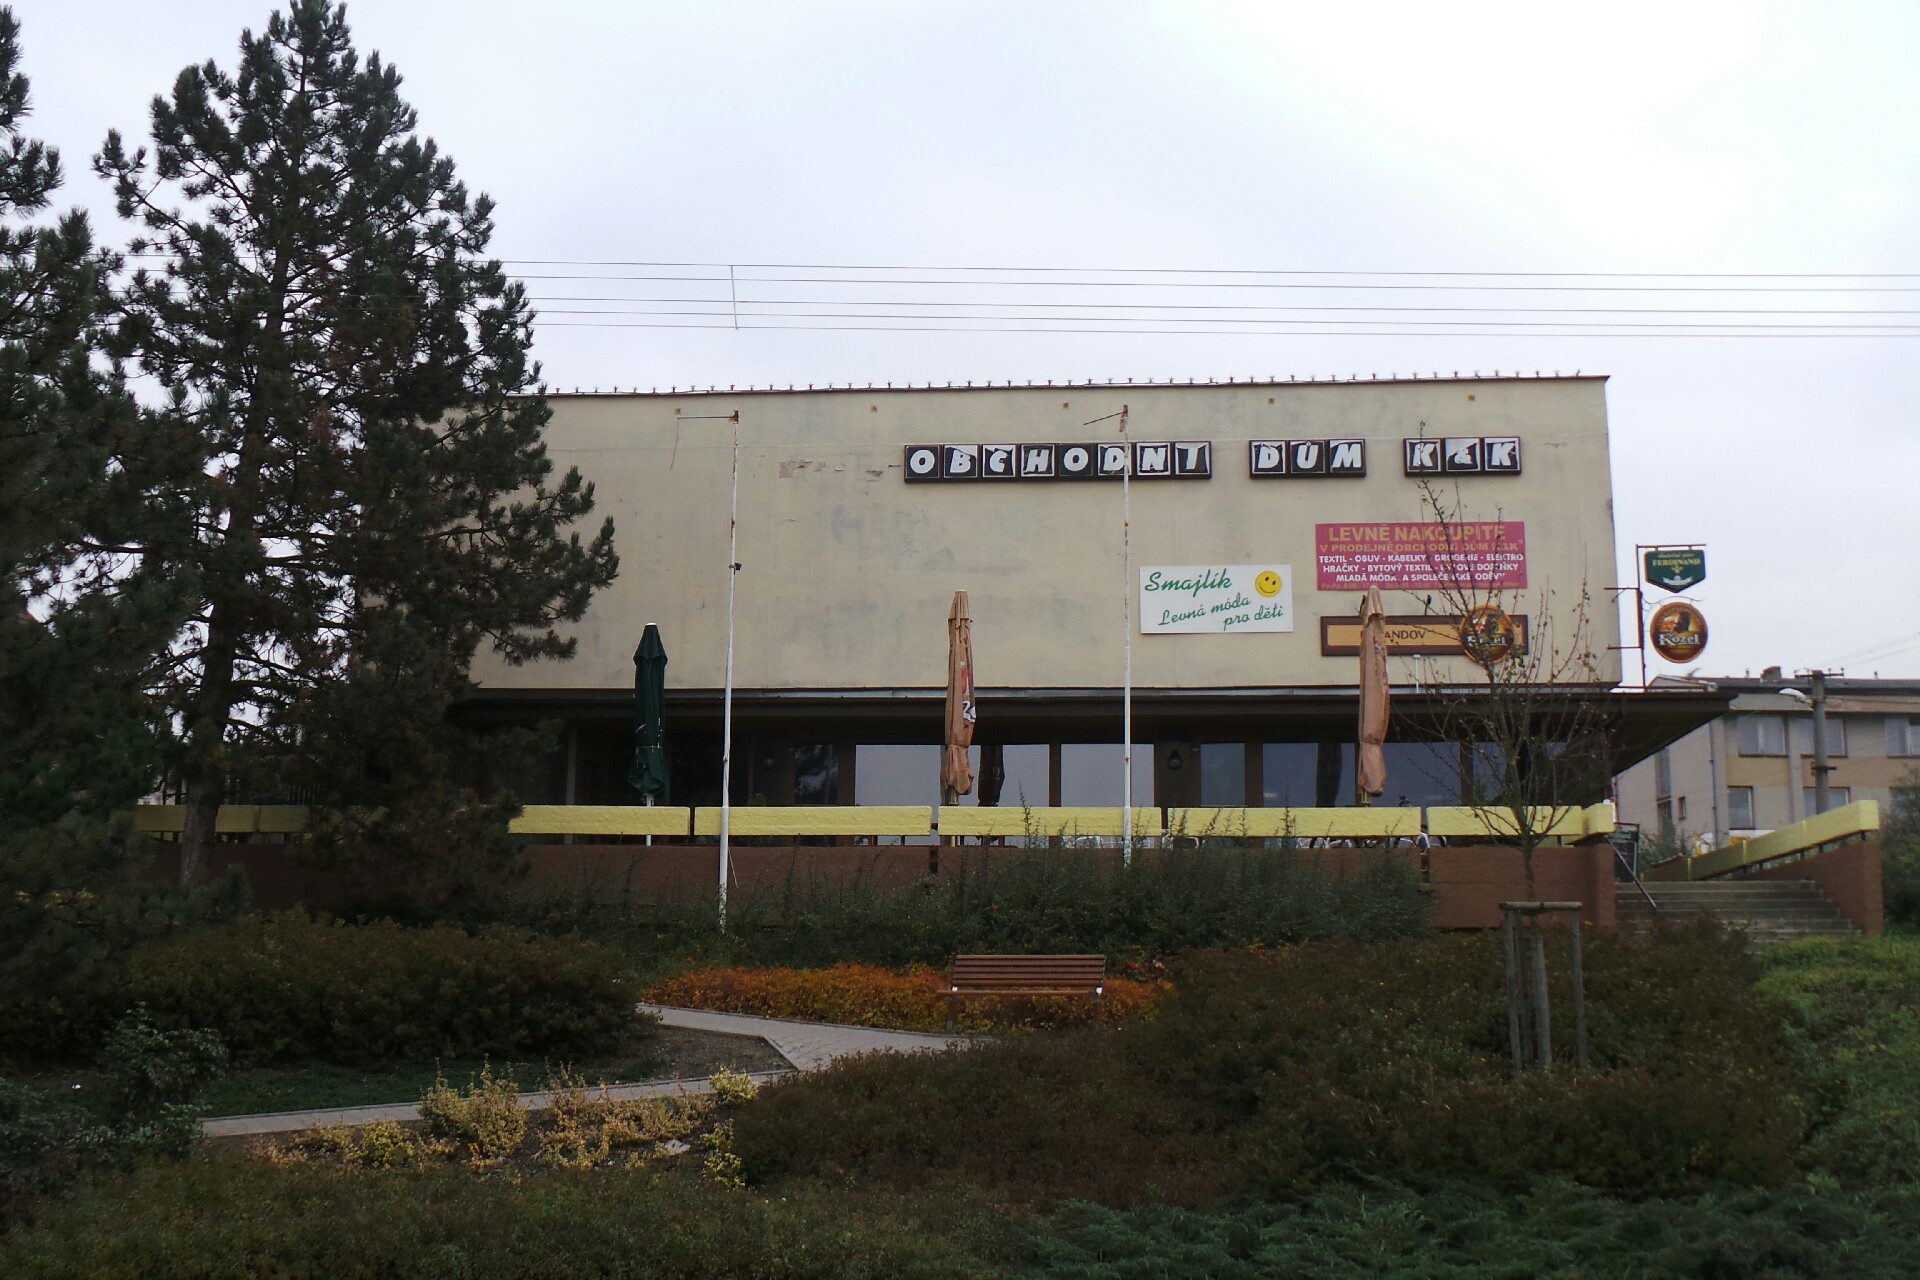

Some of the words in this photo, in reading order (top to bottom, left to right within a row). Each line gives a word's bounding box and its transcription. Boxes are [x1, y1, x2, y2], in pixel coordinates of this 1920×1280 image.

[1257, 441, 1362, 469] DŮM
[1412, 443, 1515, 467] K&K
[1328, 524, 1390, 541] LEVNĚ
[1394, 525, 1505, 541] NAKOUPITE
[1332, 541, 1393, 552] PRODEJNĚ
[1319, 555, 1347, 563] TEXTIL
[1354, 554, 1380, 562] OBUV
[1388, 554, 1426, 562] KABELKY
[1434, 553, 1478, 561] DROGERIE
[1323, 563, 1359, 572] HRAČKY
[1367, 562, 1402, 572] BYTOVÝ
[1405, 563, 1432, 571] TEXTIL
[1144, 568, 1232, 597] Smajlík
[1336, 573, 1367, 581] MLADÁ
[1369, 573, 1397, 581] MÓDA
[1158, 604, 1206, 626] Levná
[1210, 592, 1251, 614] móda
[1223, 614, 1251, 631] pro
[1254, 603, 1284, 621] děti
[1658, 633, 1701, 646] Kozel
